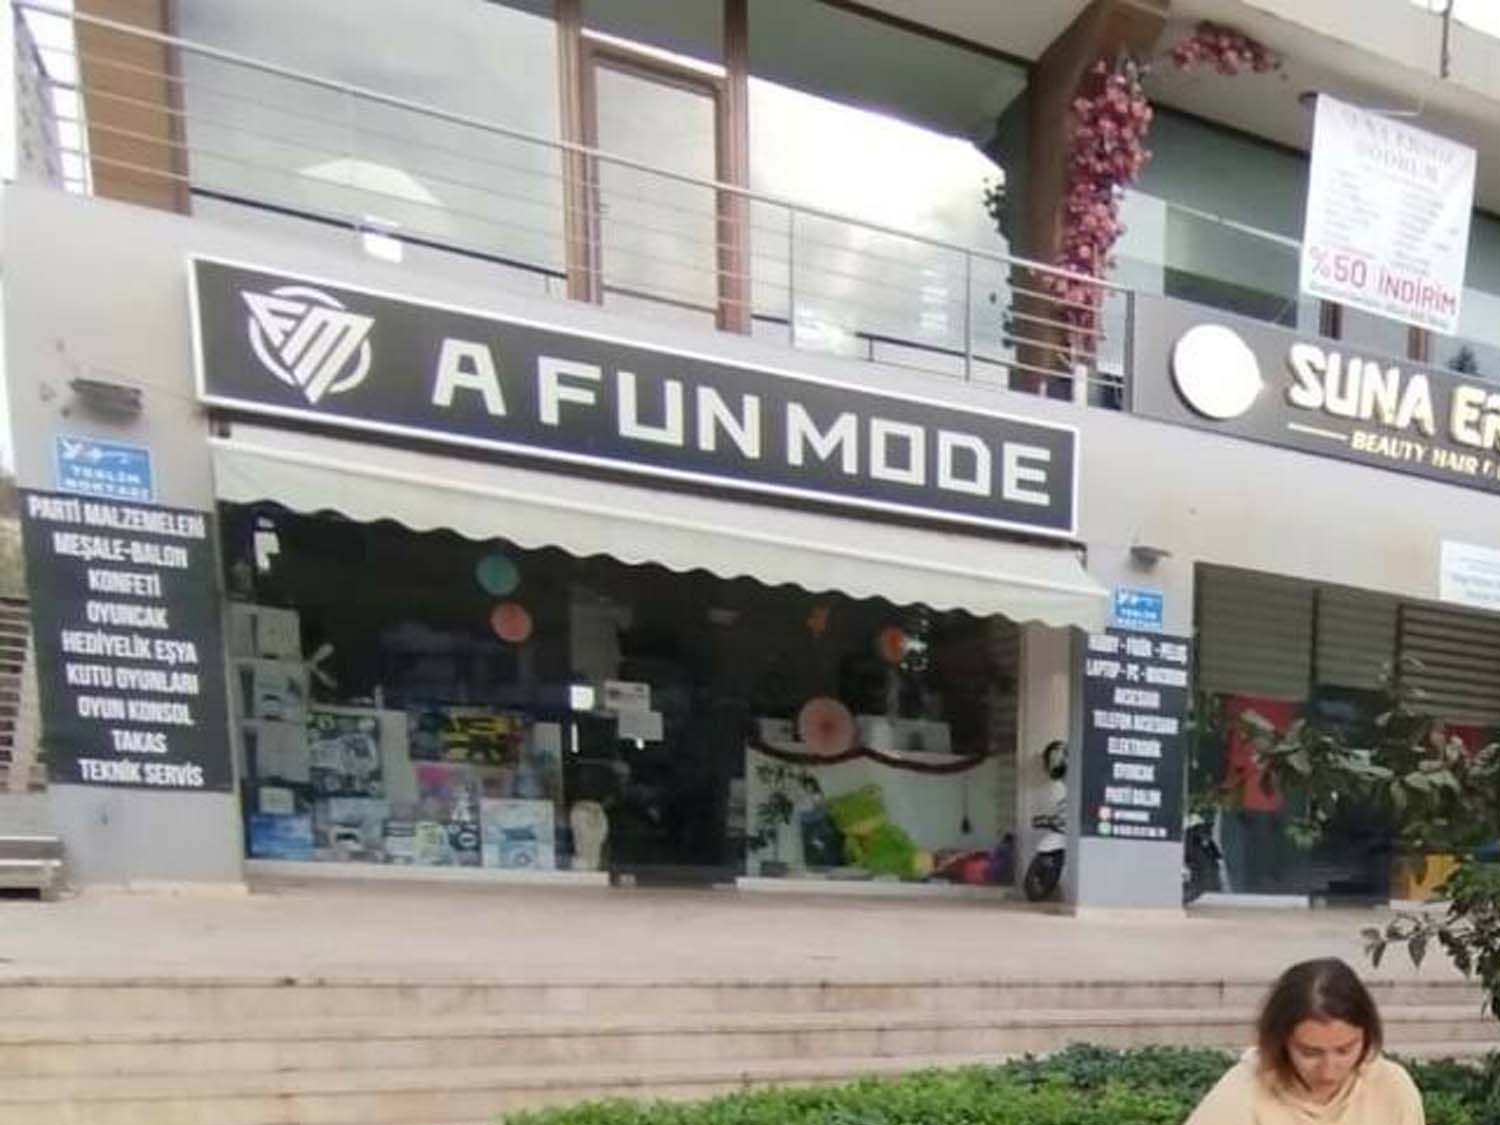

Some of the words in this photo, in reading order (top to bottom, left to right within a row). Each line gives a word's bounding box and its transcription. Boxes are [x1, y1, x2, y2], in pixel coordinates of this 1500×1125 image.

[1287, 343, 1437, 437] SUNA
[431, 336, 508, 417] A
[537, 354, 761, 461] FUN
[786, 401, 1052, 506] MODE
[1351, 428, 1426, 462] BEAUTY
[1431, 447, 1481, 476] HAIR
[87, 567, 162, 598] KONFETİ
[86, 600, 169, 630] OYUNCAK
[61, 628, 152, 660] HEDİYELİK
[154, 638, 199, 665] EŞYA
[65, 662, 113, 688] KUTU
[115, 666, 200, 695] OYUNLARI
[77, 695, 126, 720] OYUN
[127, 699, 195, 726] KONSOL
[111, 729, 168, 754] TAKAS
[77, 756, 142, 784] TEKNİK
[142, 761, 205, 788] SERVİS
